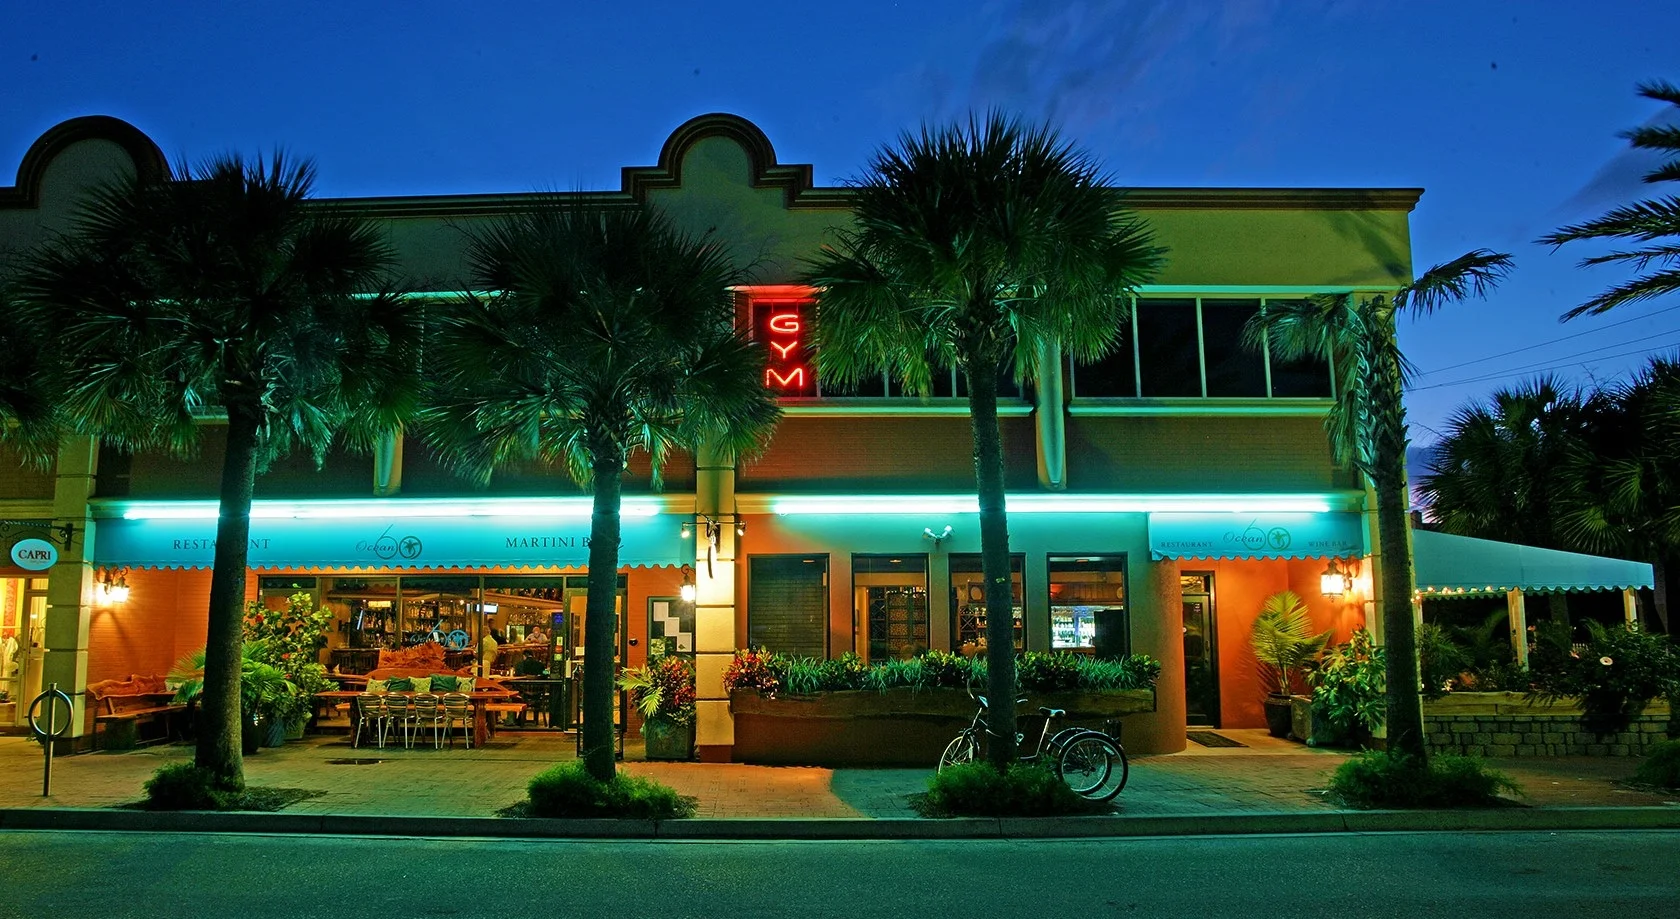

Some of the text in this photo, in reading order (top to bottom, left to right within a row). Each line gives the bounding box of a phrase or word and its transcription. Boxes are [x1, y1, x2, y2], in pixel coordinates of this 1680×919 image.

[766, 314, 803, 388] GYM
[506, 537, 575, 548] MARTINI
[1222, 531, 1263, 544] Ocean
[173, 539, 271, 550] RESTANT
[356, 540, 395, 552] Ocean
[1161, 541, 1213, 549] RESTAURANT
[18, 549, 51, 560] CAPRI
